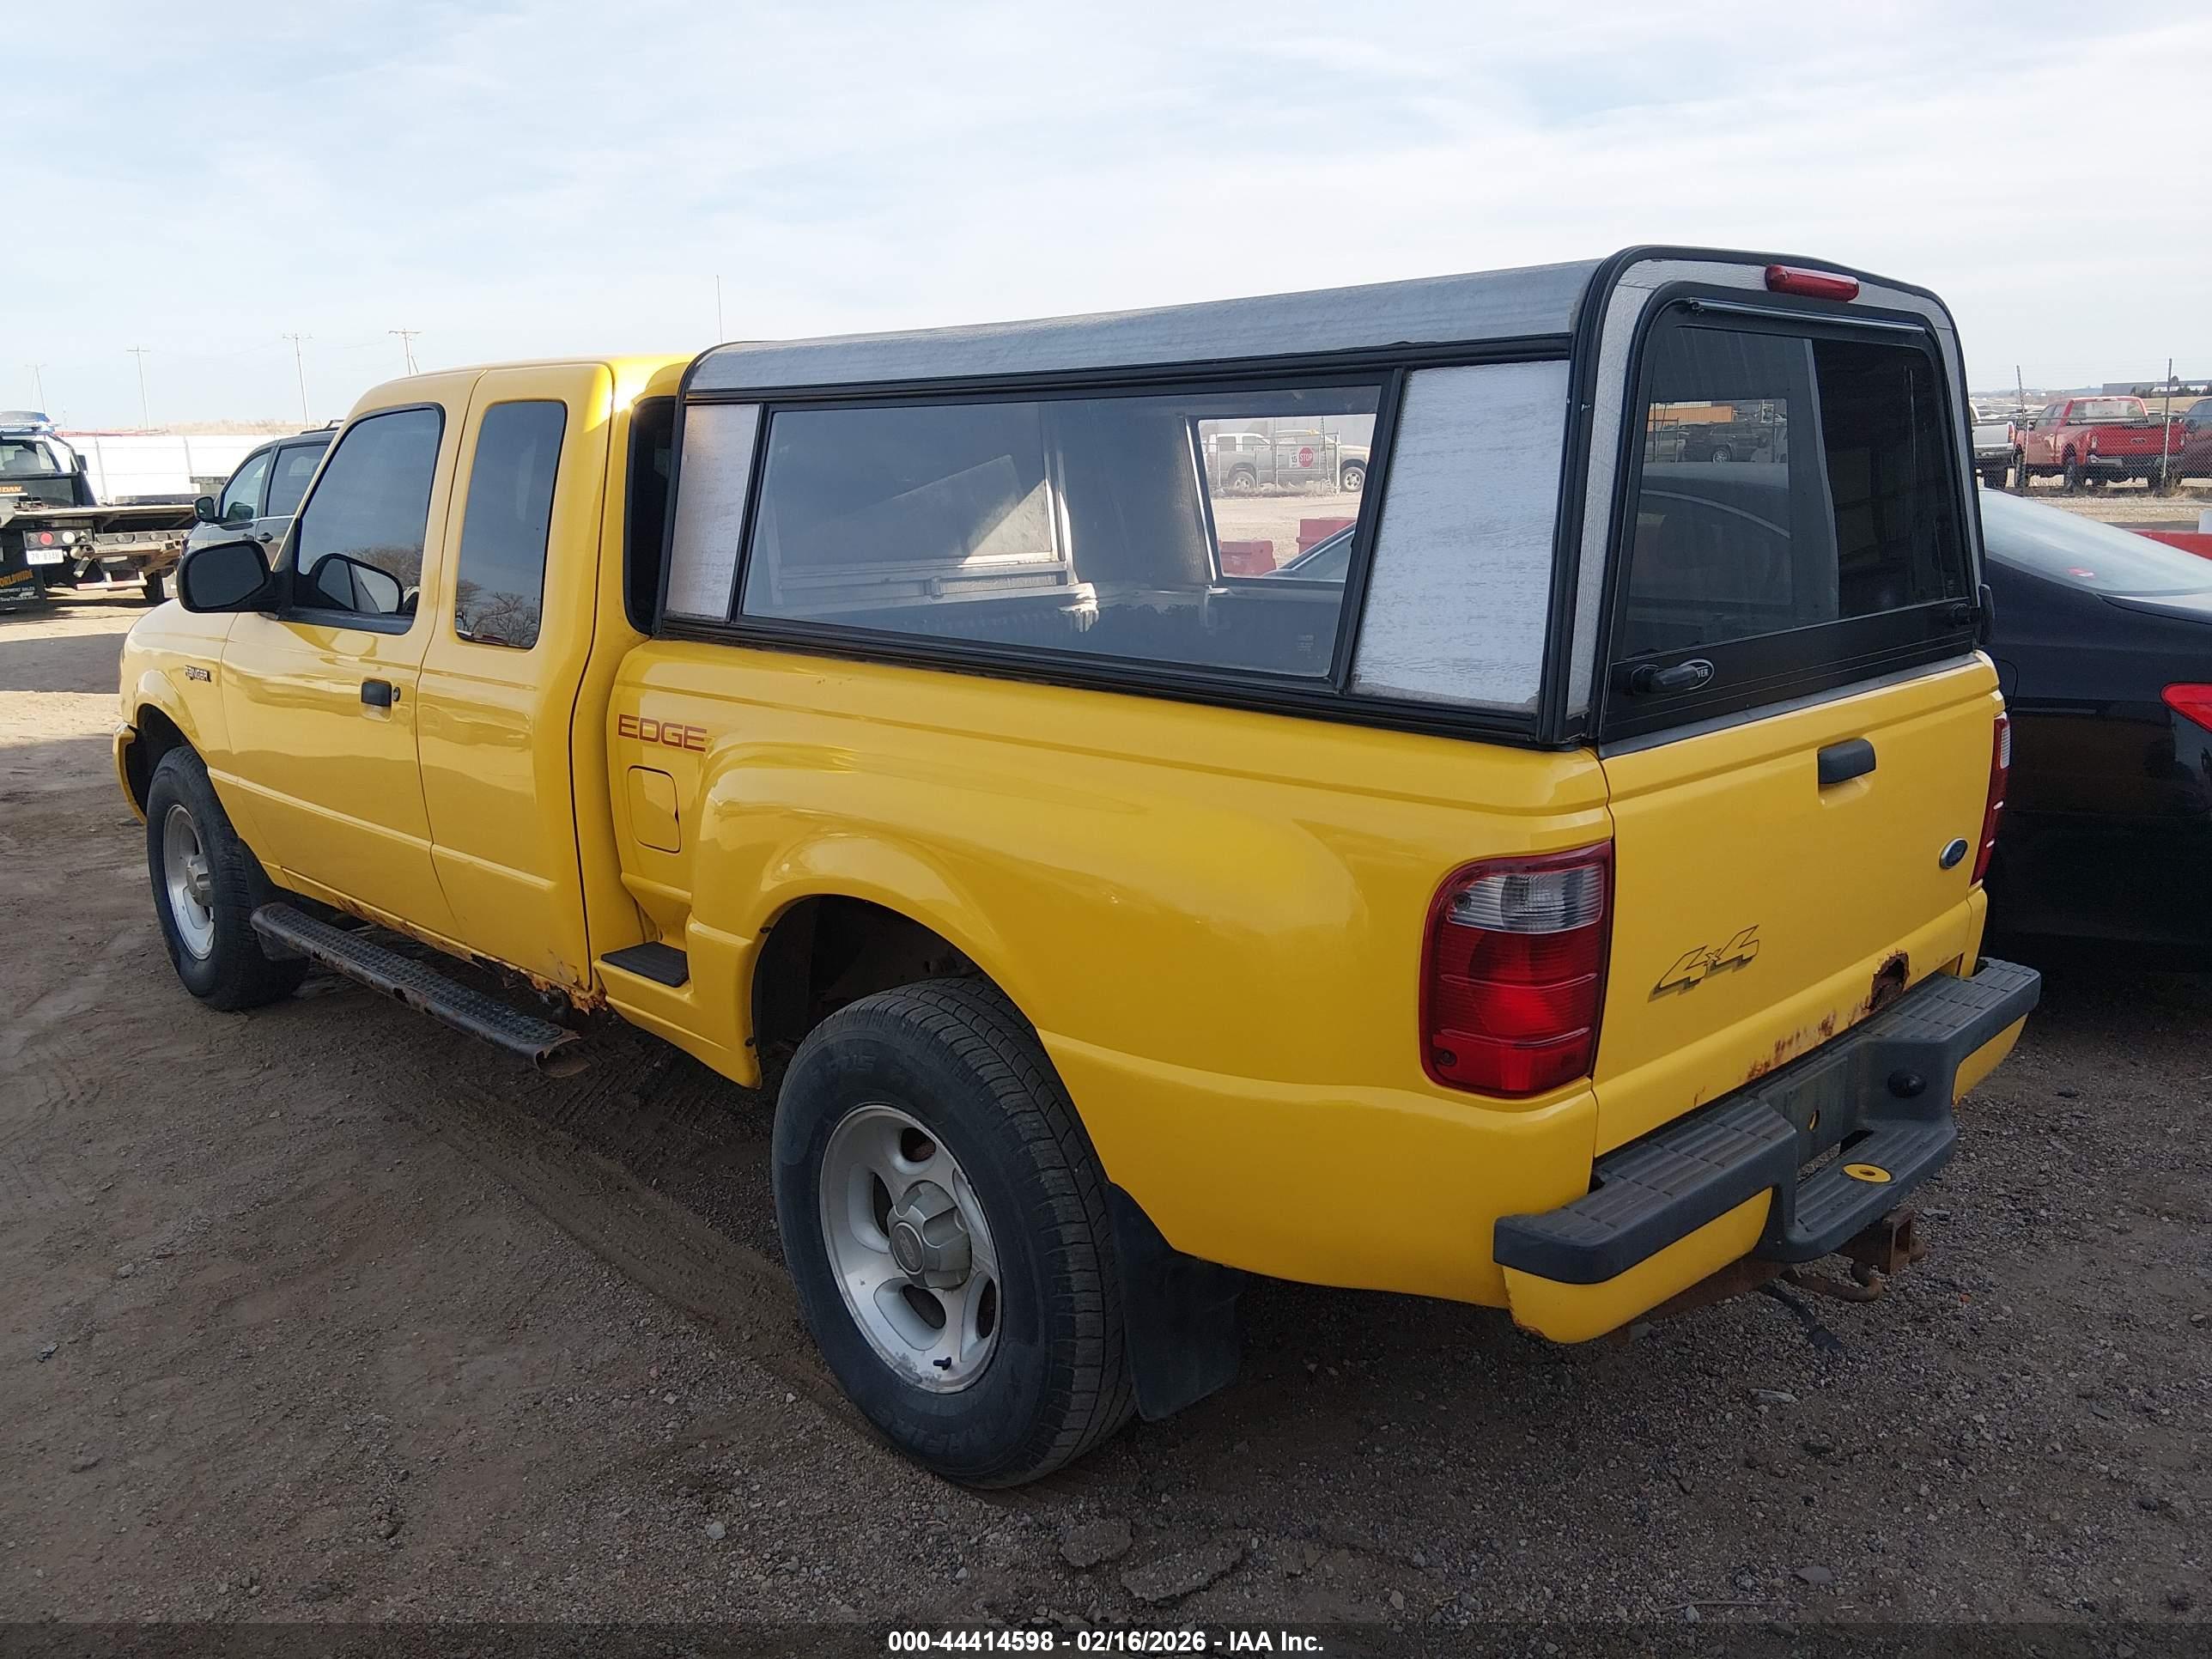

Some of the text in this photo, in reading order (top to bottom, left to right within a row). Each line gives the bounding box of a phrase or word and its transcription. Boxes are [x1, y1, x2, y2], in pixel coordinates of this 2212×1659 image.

[1299, 453, 1313, 462] STOP
[0, 569, 33, 586] ORLDWIDE
[618, 714, 707, 752] EDGE
